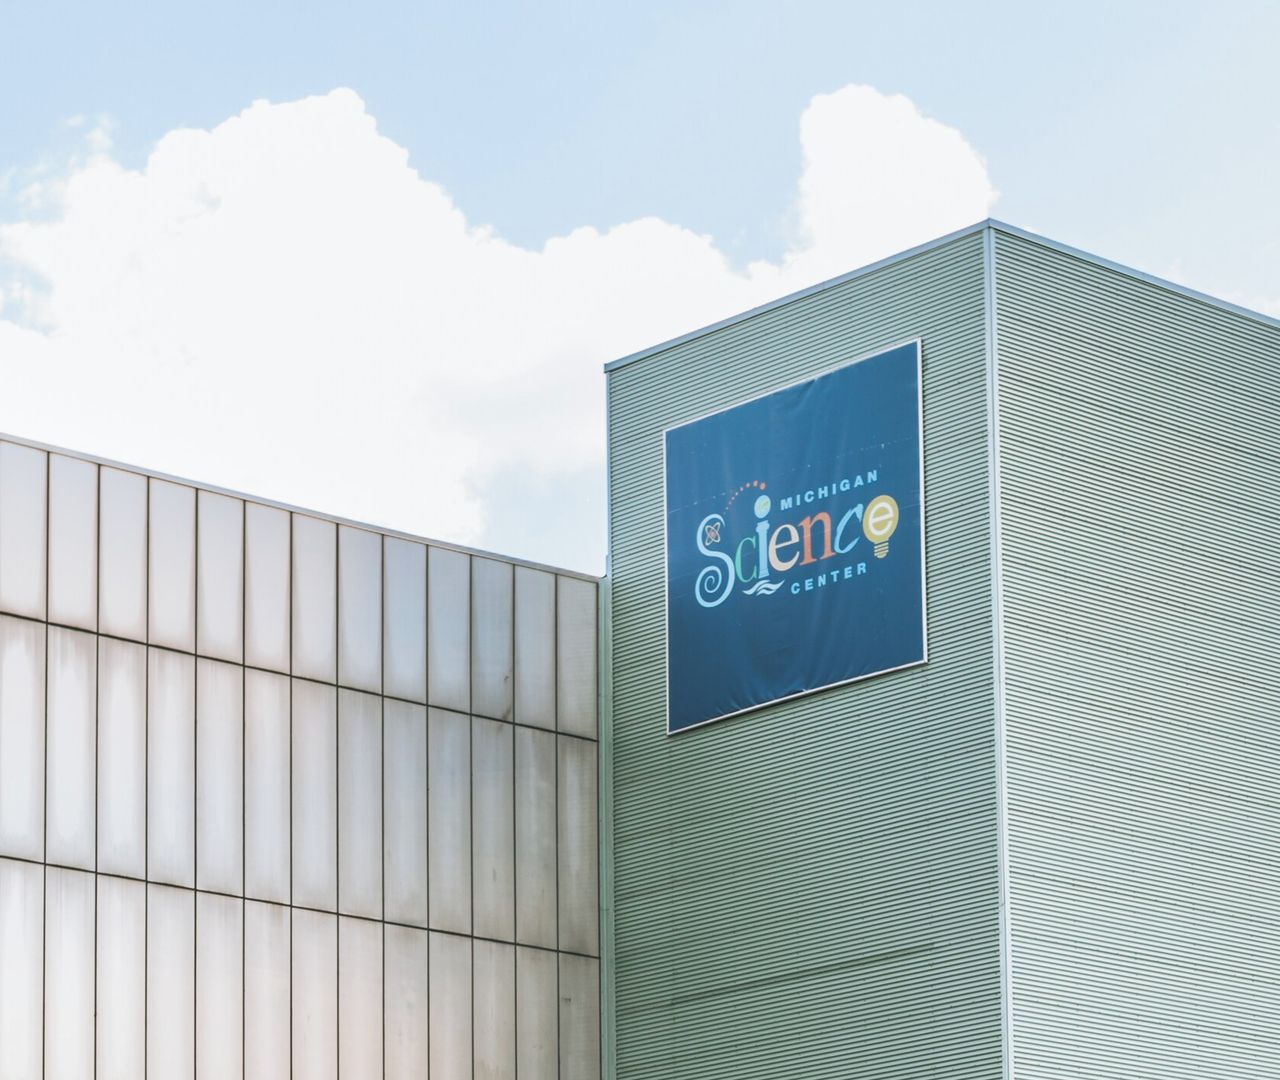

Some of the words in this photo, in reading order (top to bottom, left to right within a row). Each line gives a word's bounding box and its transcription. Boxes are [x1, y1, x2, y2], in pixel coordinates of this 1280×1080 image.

[780, 470, 878, 511] MICHIGAN
[695, 495, 899, 607] Science
[791, 562, 867, 595] CENTER
